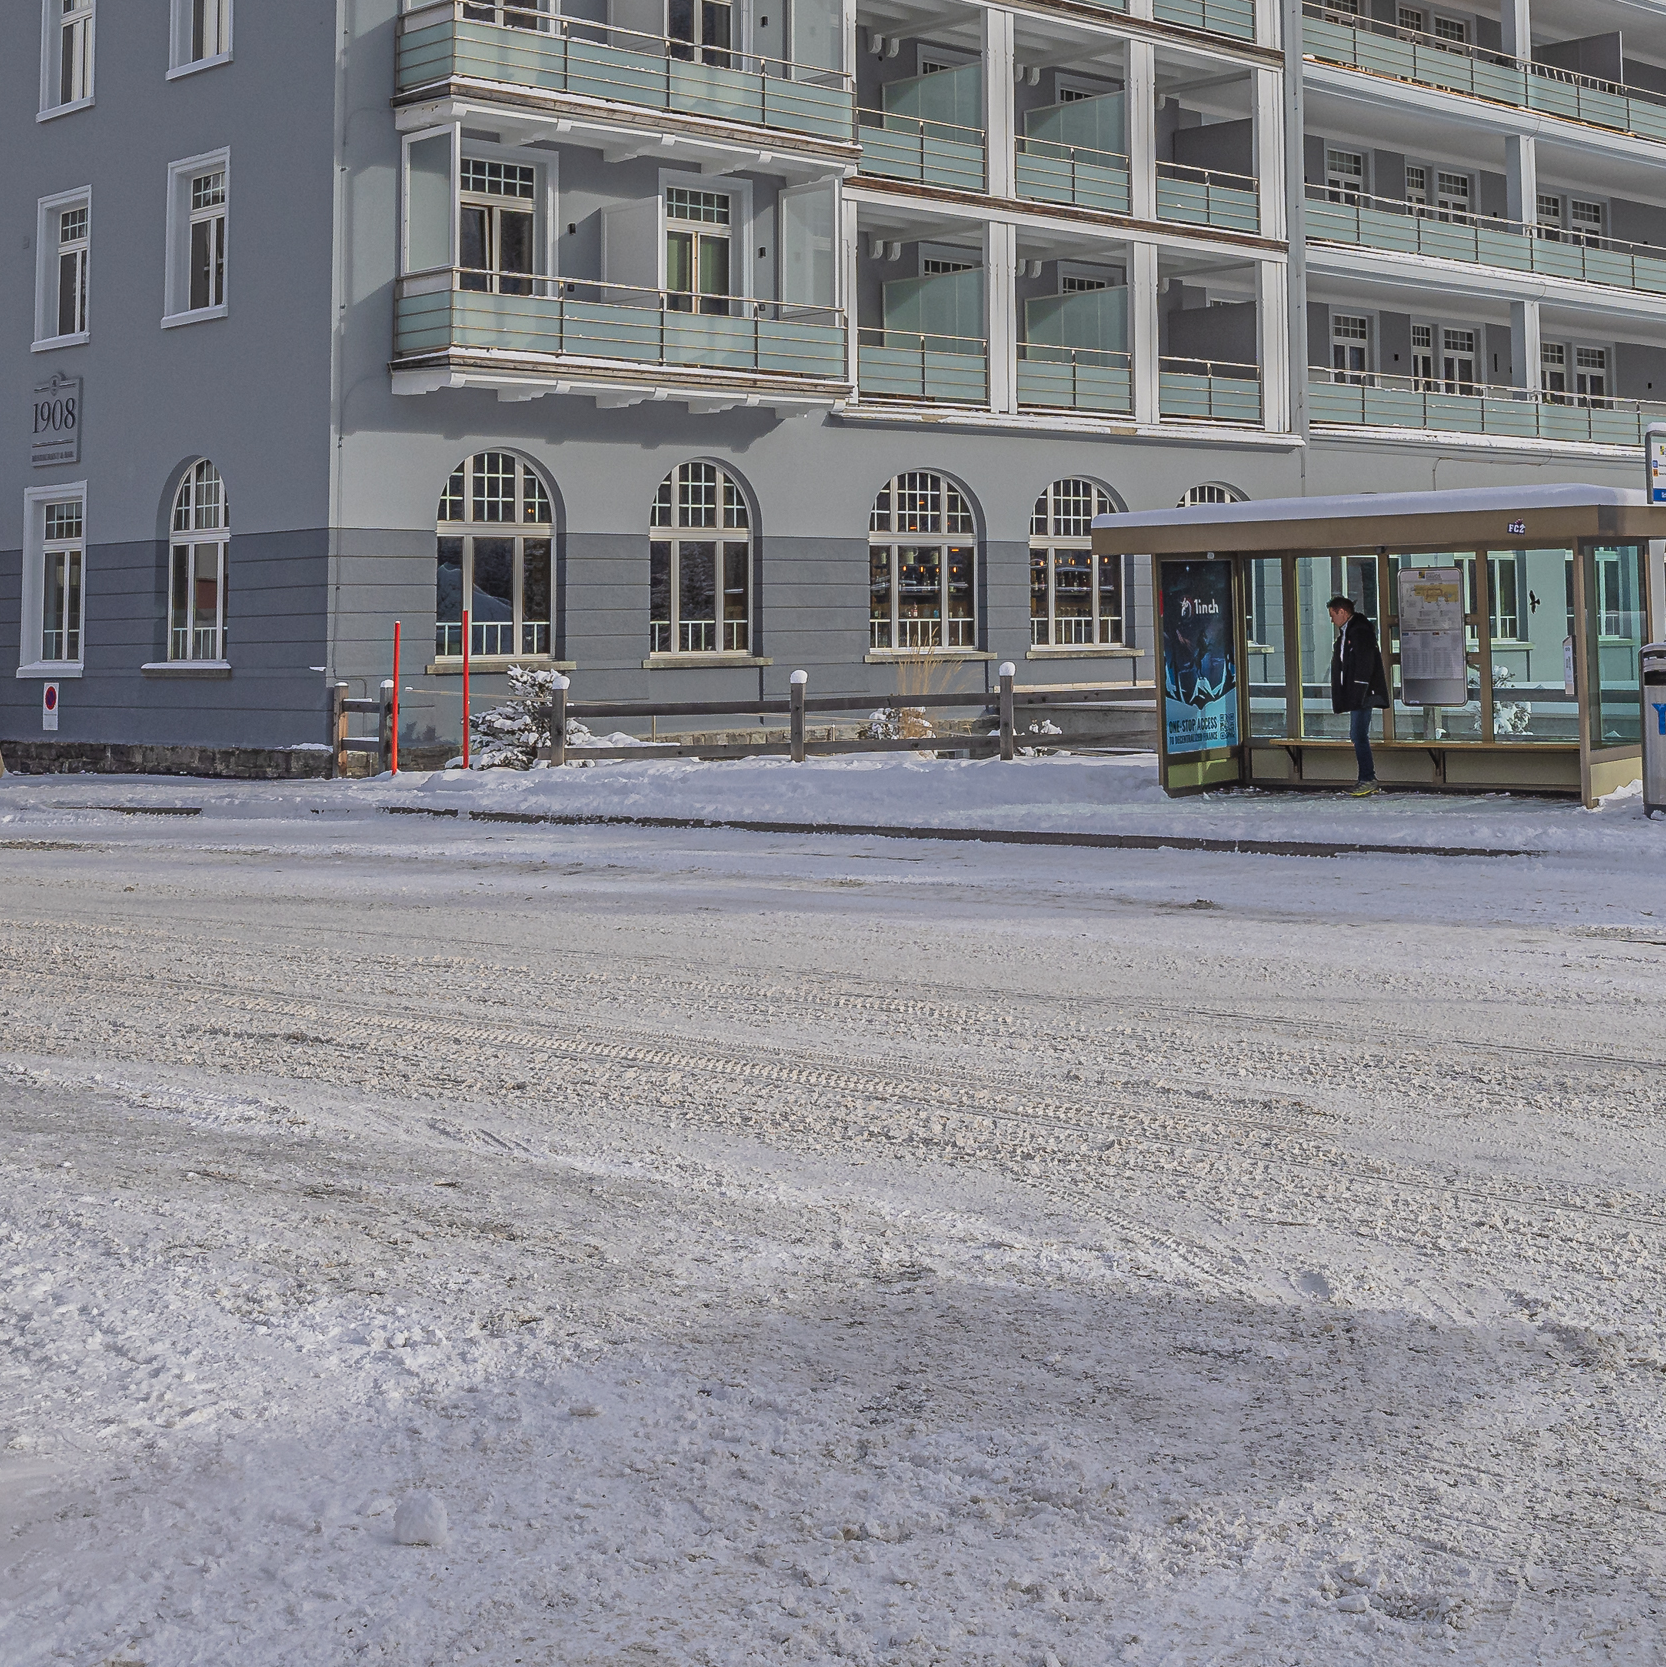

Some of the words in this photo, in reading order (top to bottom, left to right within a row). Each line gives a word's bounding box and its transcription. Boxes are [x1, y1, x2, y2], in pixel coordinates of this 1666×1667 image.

[32, 397, 75, 433] 1908
[1194, 599, 1219, 614] 1inch
[1169, 719, 1196, 733] ONE-STOP
[1197, 716, 1217, 731] ACCESS
